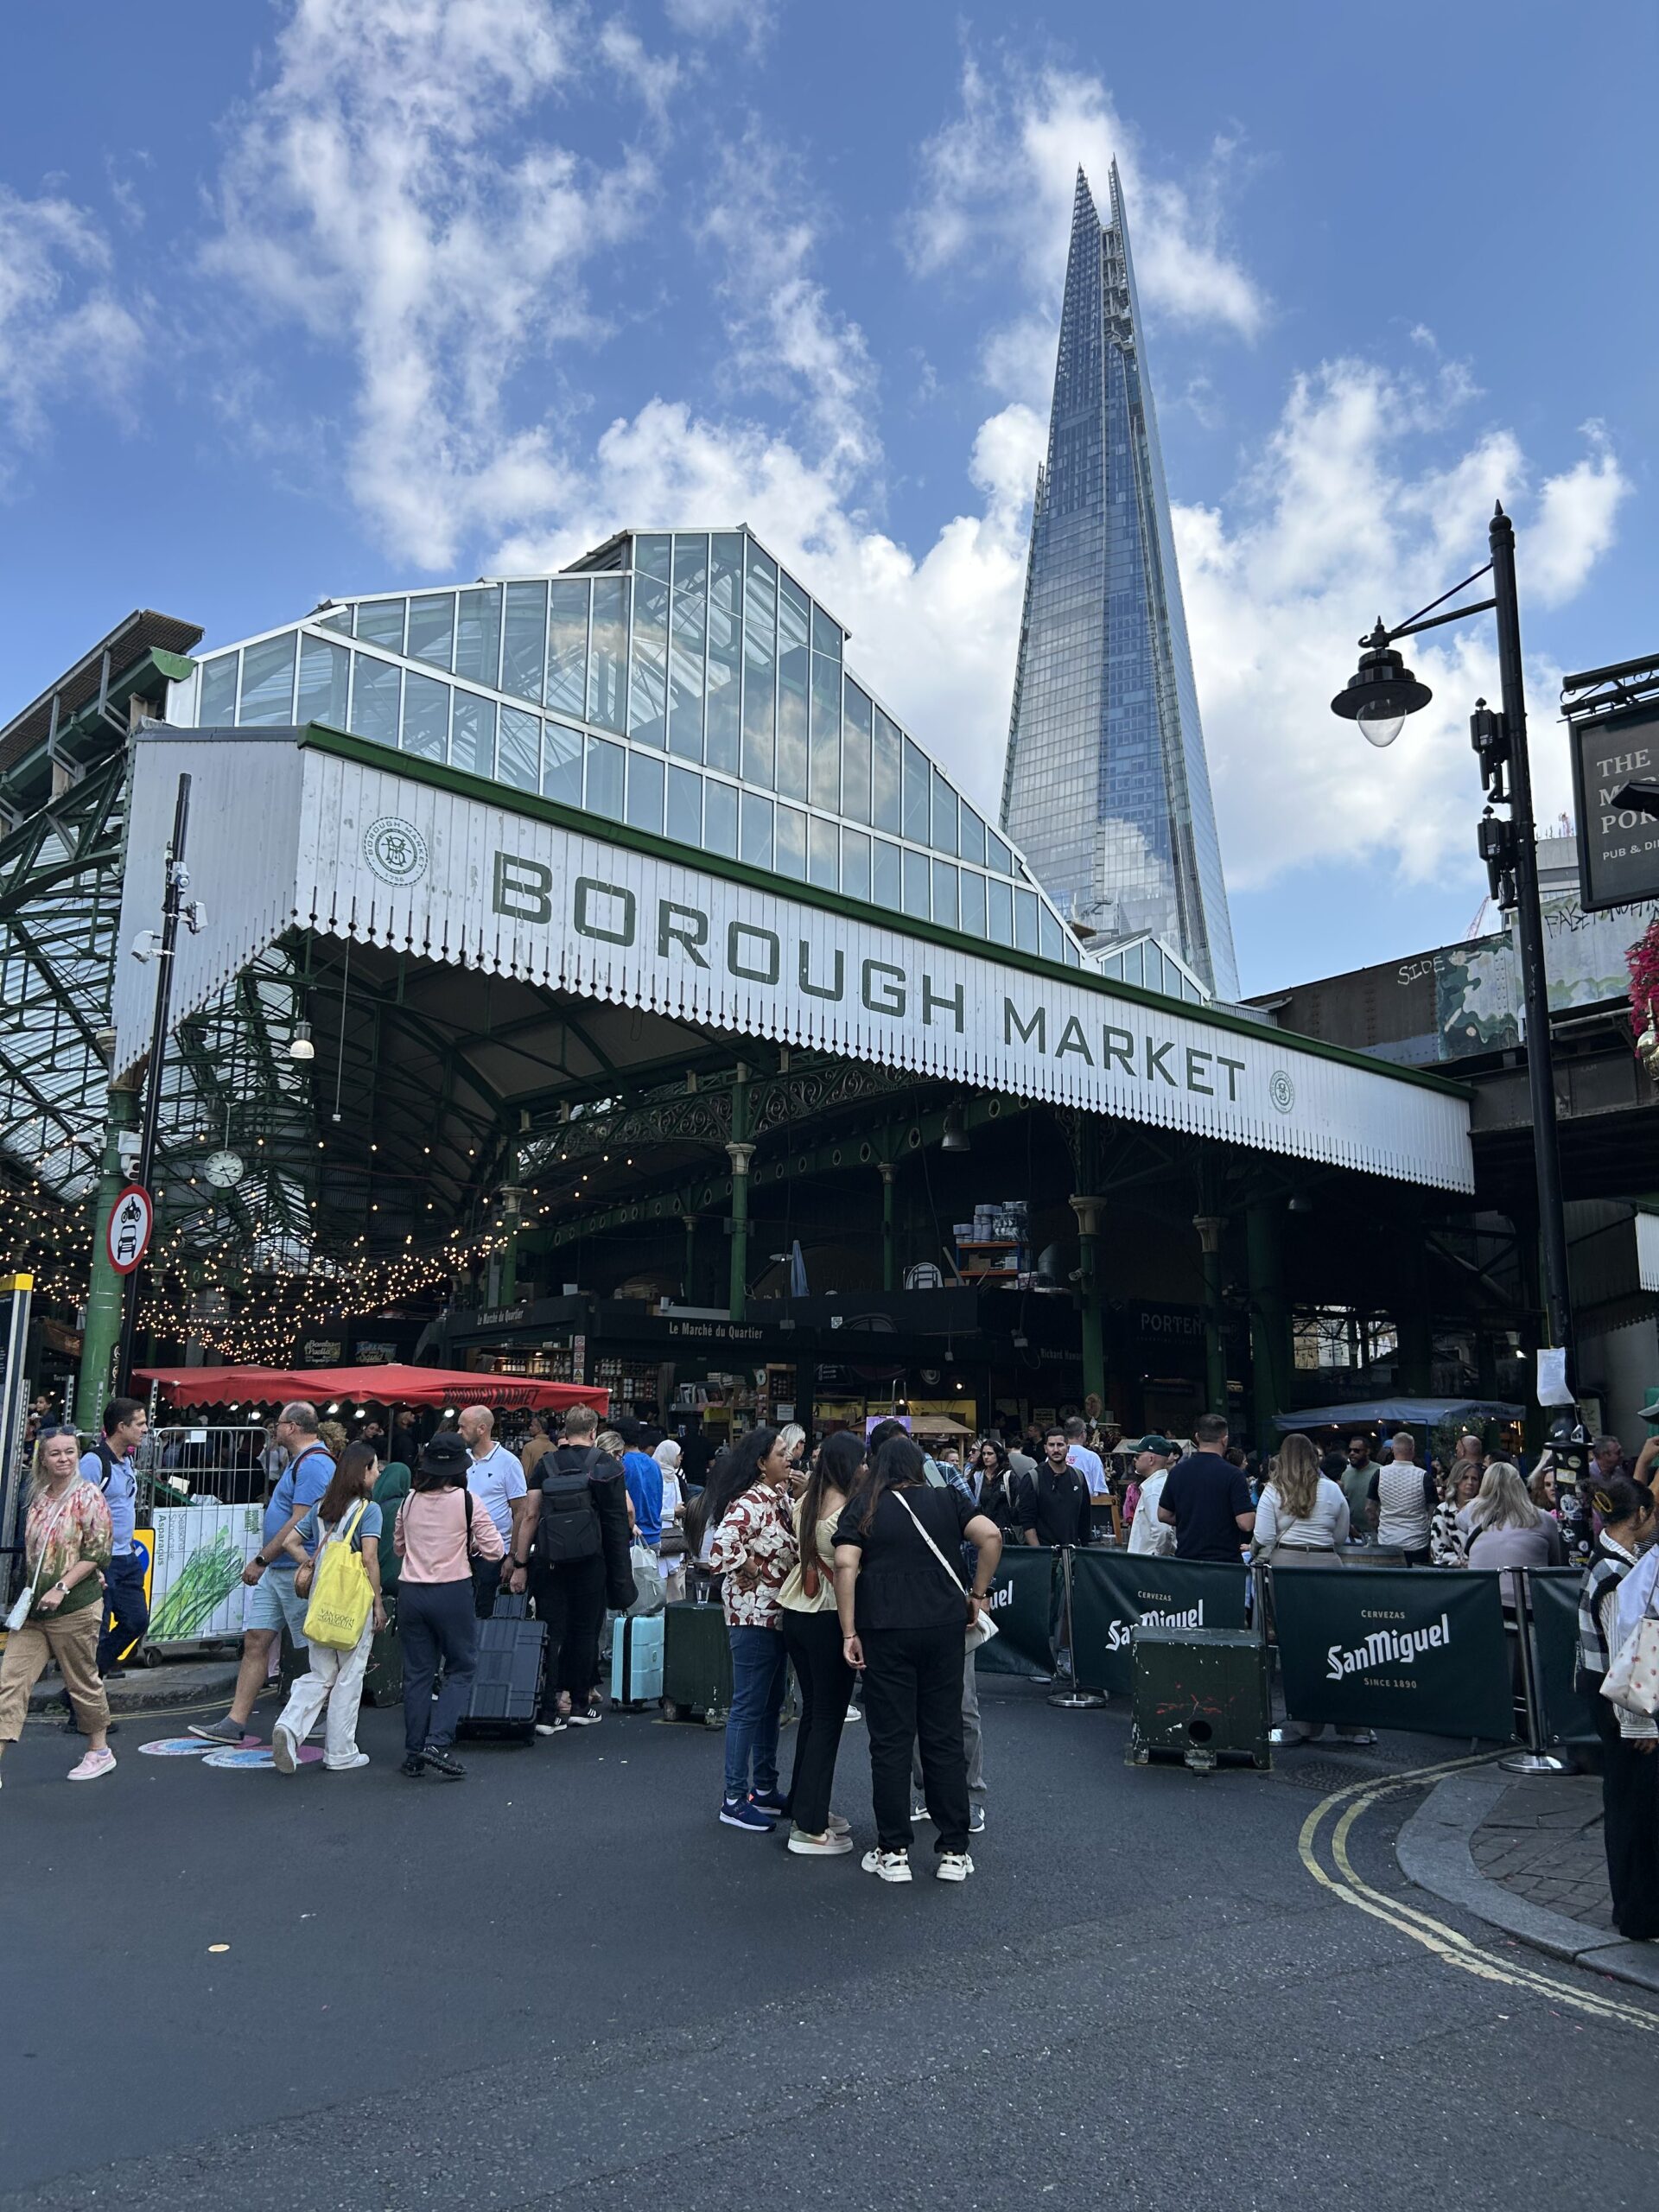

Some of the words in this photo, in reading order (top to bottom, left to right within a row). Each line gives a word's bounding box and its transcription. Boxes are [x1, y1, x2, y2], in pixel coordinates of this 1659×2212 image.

[1597, 748, 1651, 778] THE
[367, 821, 401, 855] BOROUGH
[405, 827, 425, 868] MARKET
[1602, 848, 1627, 861] PUB
[1630, 845, 1642, 854] &
[493, 850, 964, 1034] BOROUGH
[1004, 996, 1245, 1103] MARKET
[1397, 956, 1446, 986] SIDE
[669, 1321, 679, 1335] Le
[682, 1322, 713, 1337] Marché
[715, 1325, 726, 1337] du
[728, 1325, 764, 1339] Quartier
[443, 1388, 493, 1404] BOROUGH
[493, 1388, 540, 1405] MARKET
[157, 1515, 167, 1567] Asparagus
[1138, 1591, 1172, 1602] CERVEZAS
[1361, 1610, 1405, 1619] CERVEZAS
[1363, 1677, 1390, 1688] SINCE
[1394, 1680, 1417, 1688] 1890
